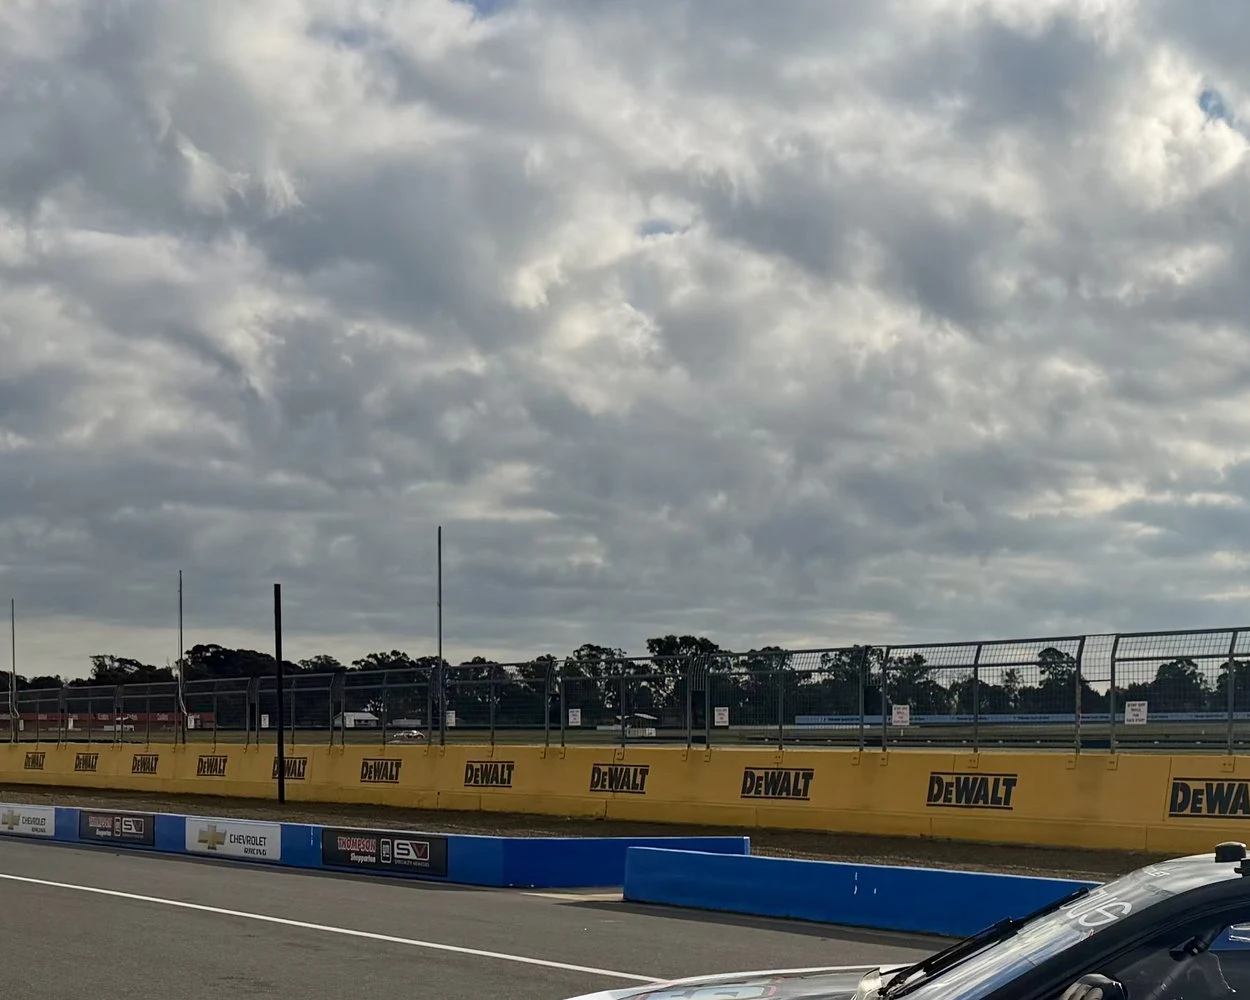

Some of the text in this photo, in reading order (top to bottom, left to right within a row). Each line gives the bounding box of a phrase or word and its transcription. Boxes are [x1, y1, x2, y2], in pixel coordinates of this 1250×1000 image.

[198, 757, 227, 775] DeWALT
[273, 759, 307, 778] DWALT
[361, 761, 402, 781] DeWALT
[464, 763, 514, 785] DeWALT
[590, 766, 649, 791] DeWALT
[741, 770, 813, 798] DeWALT
[927, 775, 1017, 806] DeWALT
[230, 834, 267, 846] CHEVROLET
[337, 836, 376, 853] THOMPSON
[244, 847, 267, 856] RACING
